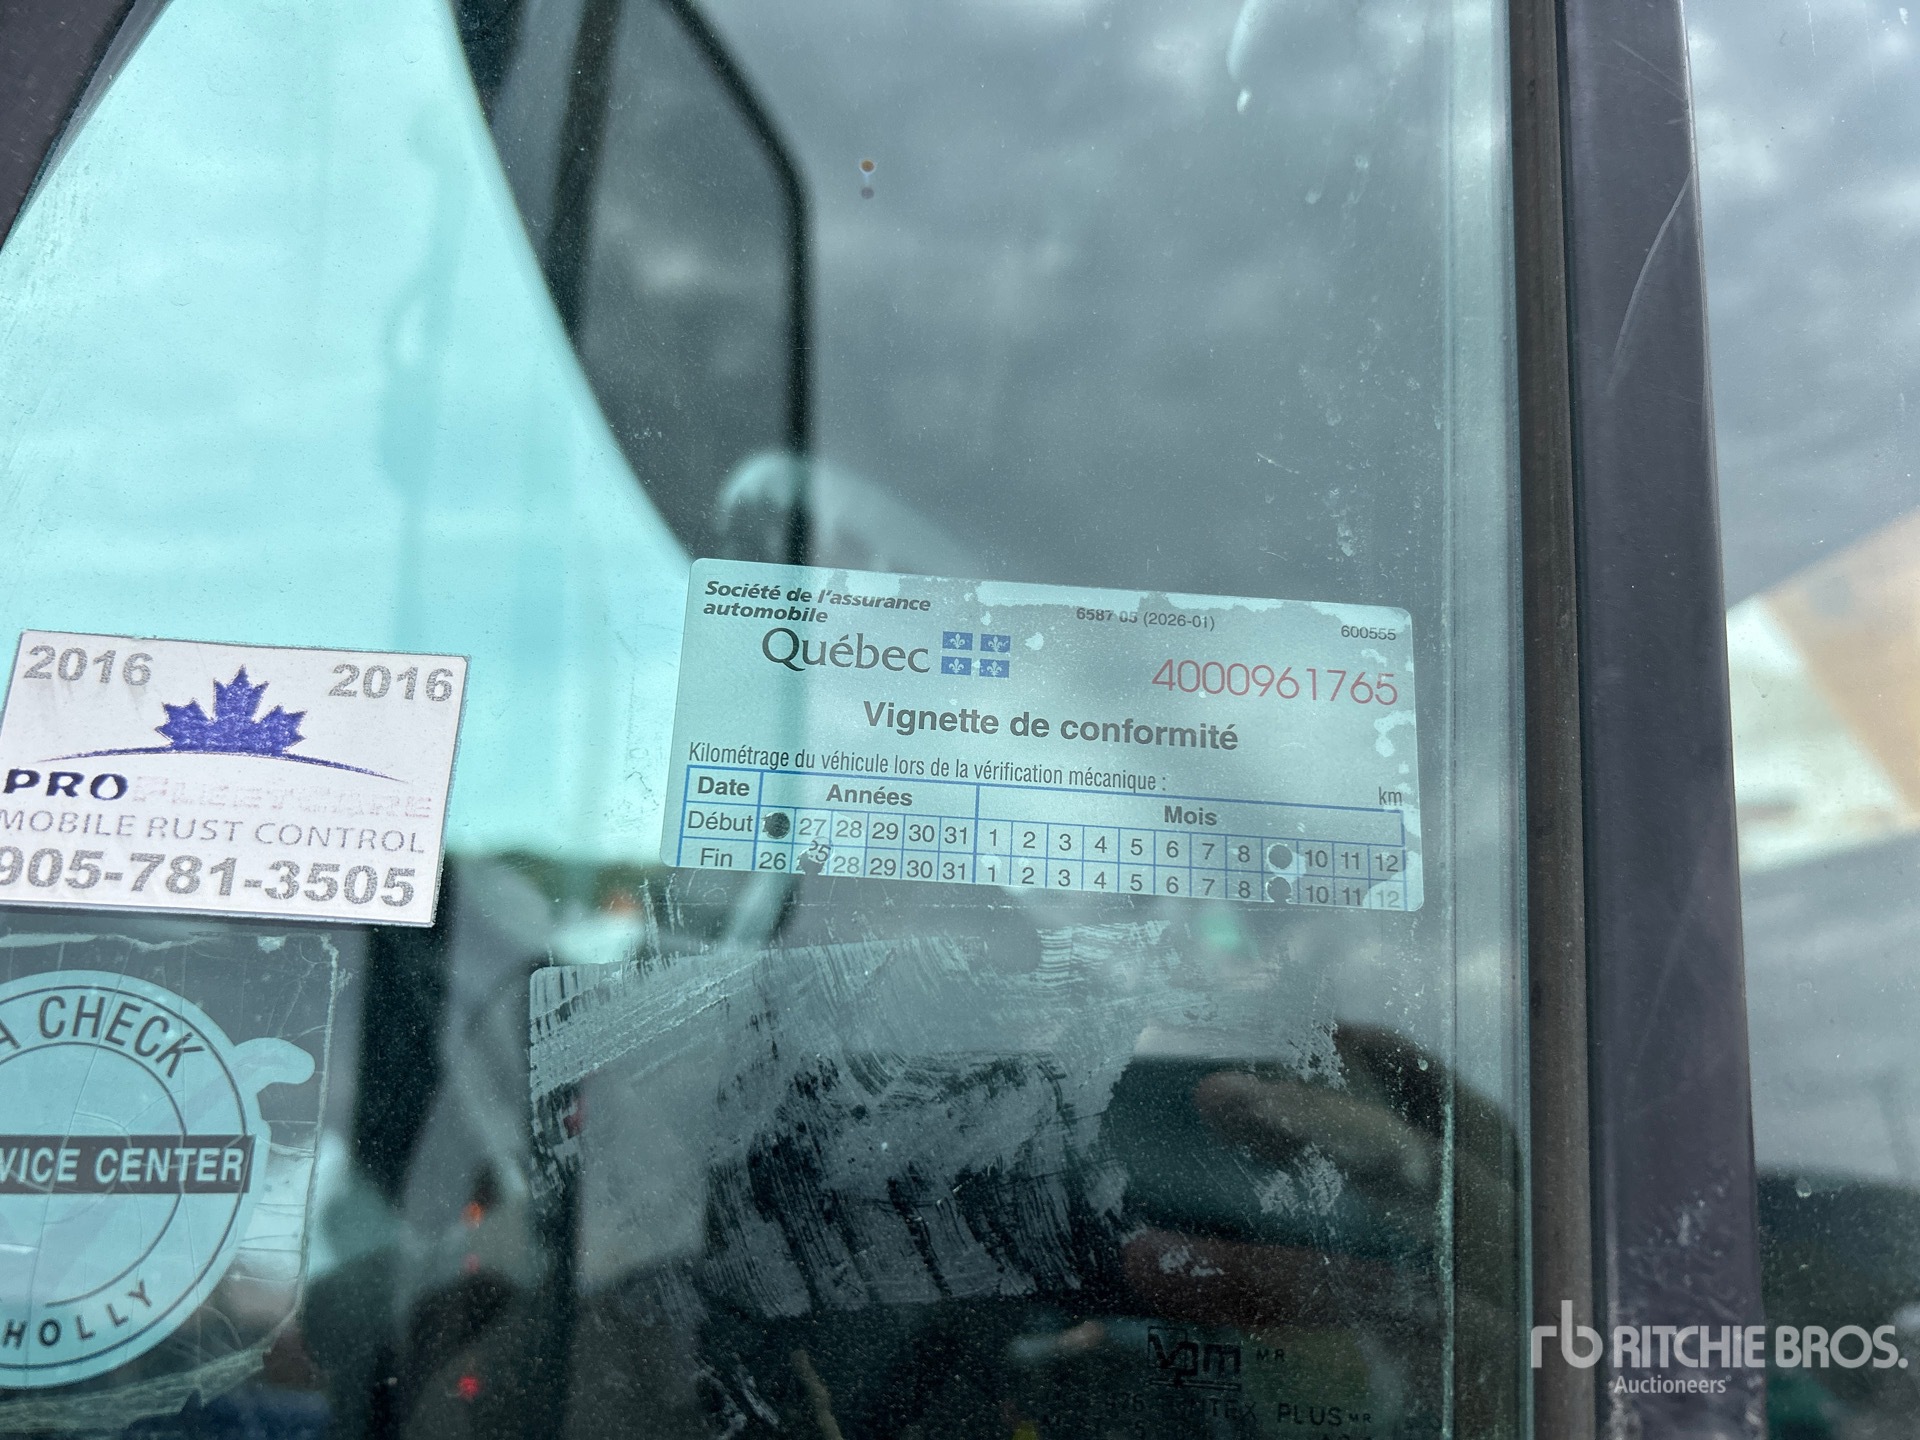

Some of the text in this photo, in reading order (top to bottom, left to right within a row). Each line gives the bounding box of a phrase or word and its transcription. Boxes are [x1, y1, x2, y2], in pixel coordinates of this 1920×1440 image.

[703, 602, 828, 623] automobile
[705, 580, 931, 612] Société de l'assurance
[1076, 607, 1113, 622] 6587
[1143, 612, 1215, 631] (2026-01)
[1340, 625, 1397, 641] 600555
[23, 644, 154, 687] 2016
[762, 627, 931, 673] Québec
[328, 663, 454, 702] 2016
[1151, 658, 1398, 706] 4000961765
[863, 701, 1239, 750] Vignette de conformité
[3, 768, 129, 801] PRO
[689, 741, 790, 770] Kilométrage
[795, 748, 815, 769] du
[821, 751, 889, 774] véhicule
[894, 757, 925, 776] lors
[930, 759, 950, 778] de
[955, 759, 969, 778] la
[974, 761, 1063, 785] vérification
[1068, 767, 1157, 794] mécanique
[697, 776, 1218, 826] Date Années Mois
[1379, 787, 1403, 806] km
[0, 809, 424, 853] MOBILE RUST CONTROL
[688, 811, 1399, 873] Début 27 28 29 30 31 1 2 3 4 5 6 7 8 10 11 12
[0, 846, 415, 907] 905-781-3505
[700, 848, 1400, 909] Fin 26 28 29 30 31 1 2 3 4 5 6 7 8 10 11 12
[39, 995, 205, 1078] CHECK
[94, 1147, 245, 1183] CENTER
[2, 1279, 152, 1349] HOLLY
[1277, 1402, 1342, 1426] PLUS
